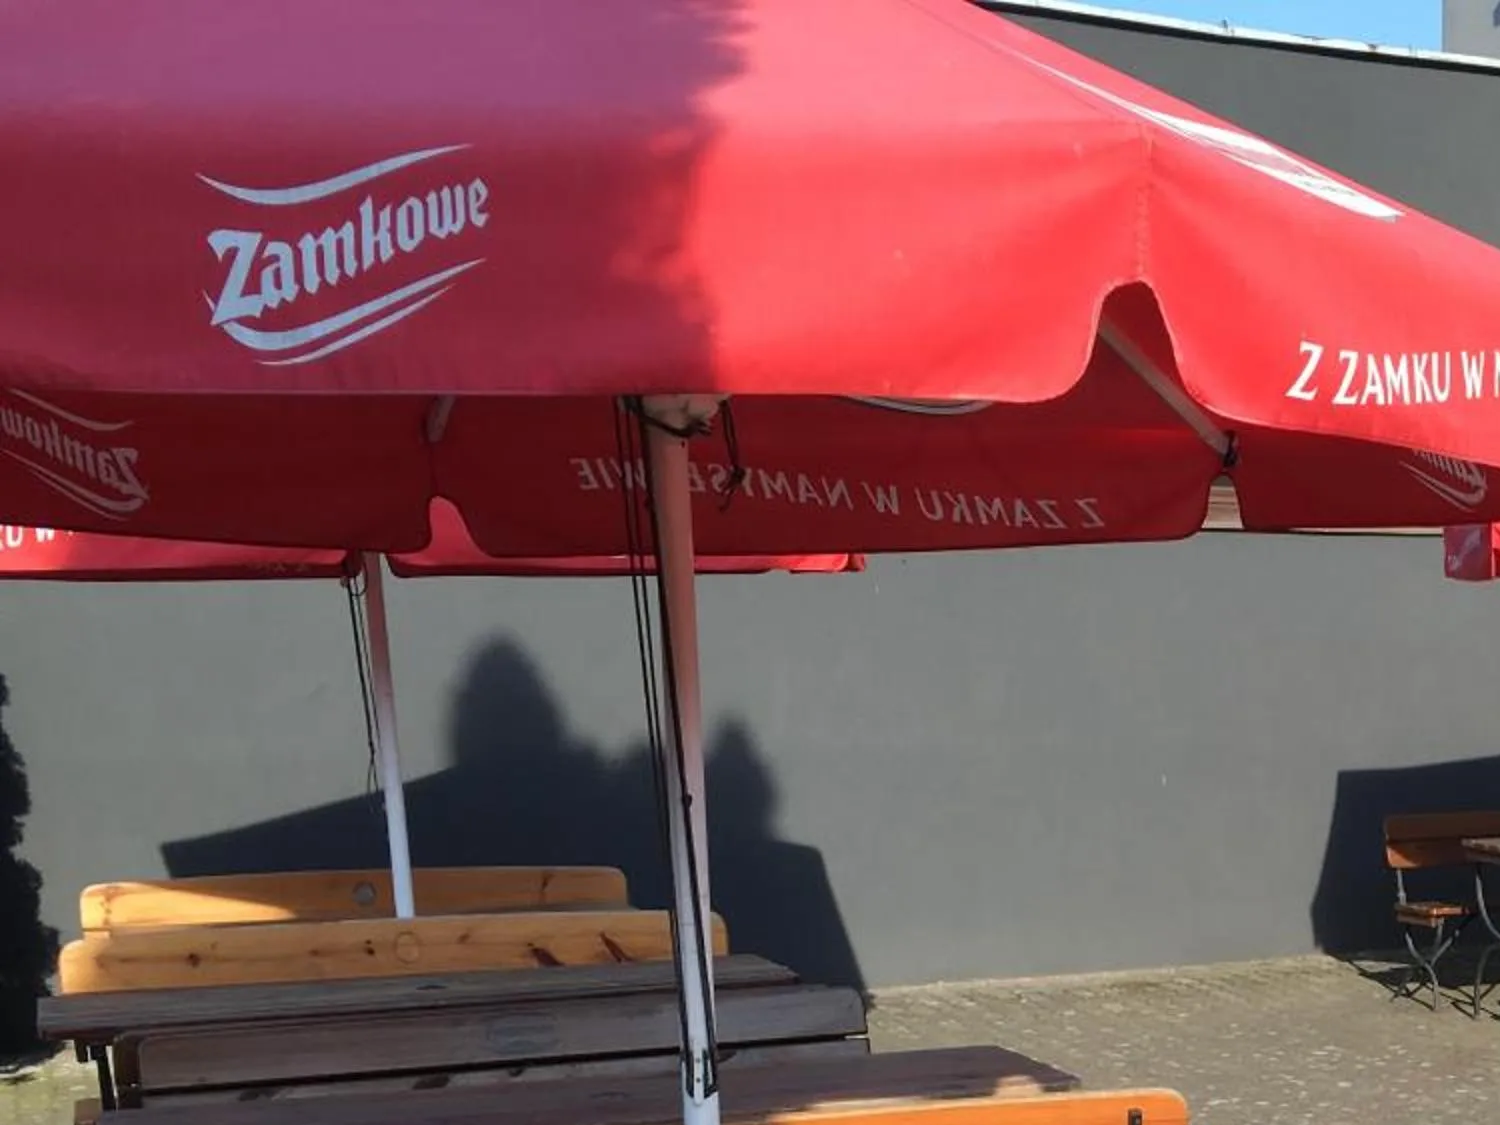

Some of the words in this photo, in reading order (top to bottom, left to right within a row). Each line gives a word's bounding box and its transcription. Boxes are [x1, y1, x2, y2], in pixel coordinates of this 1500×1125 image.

[207, 177, 490, 326] Zamkowe
[1284, 340, 1325, 401] Z
[1332, 349, 1451, 406] ZAMKU
[1460, 351, 1485, 400] W
